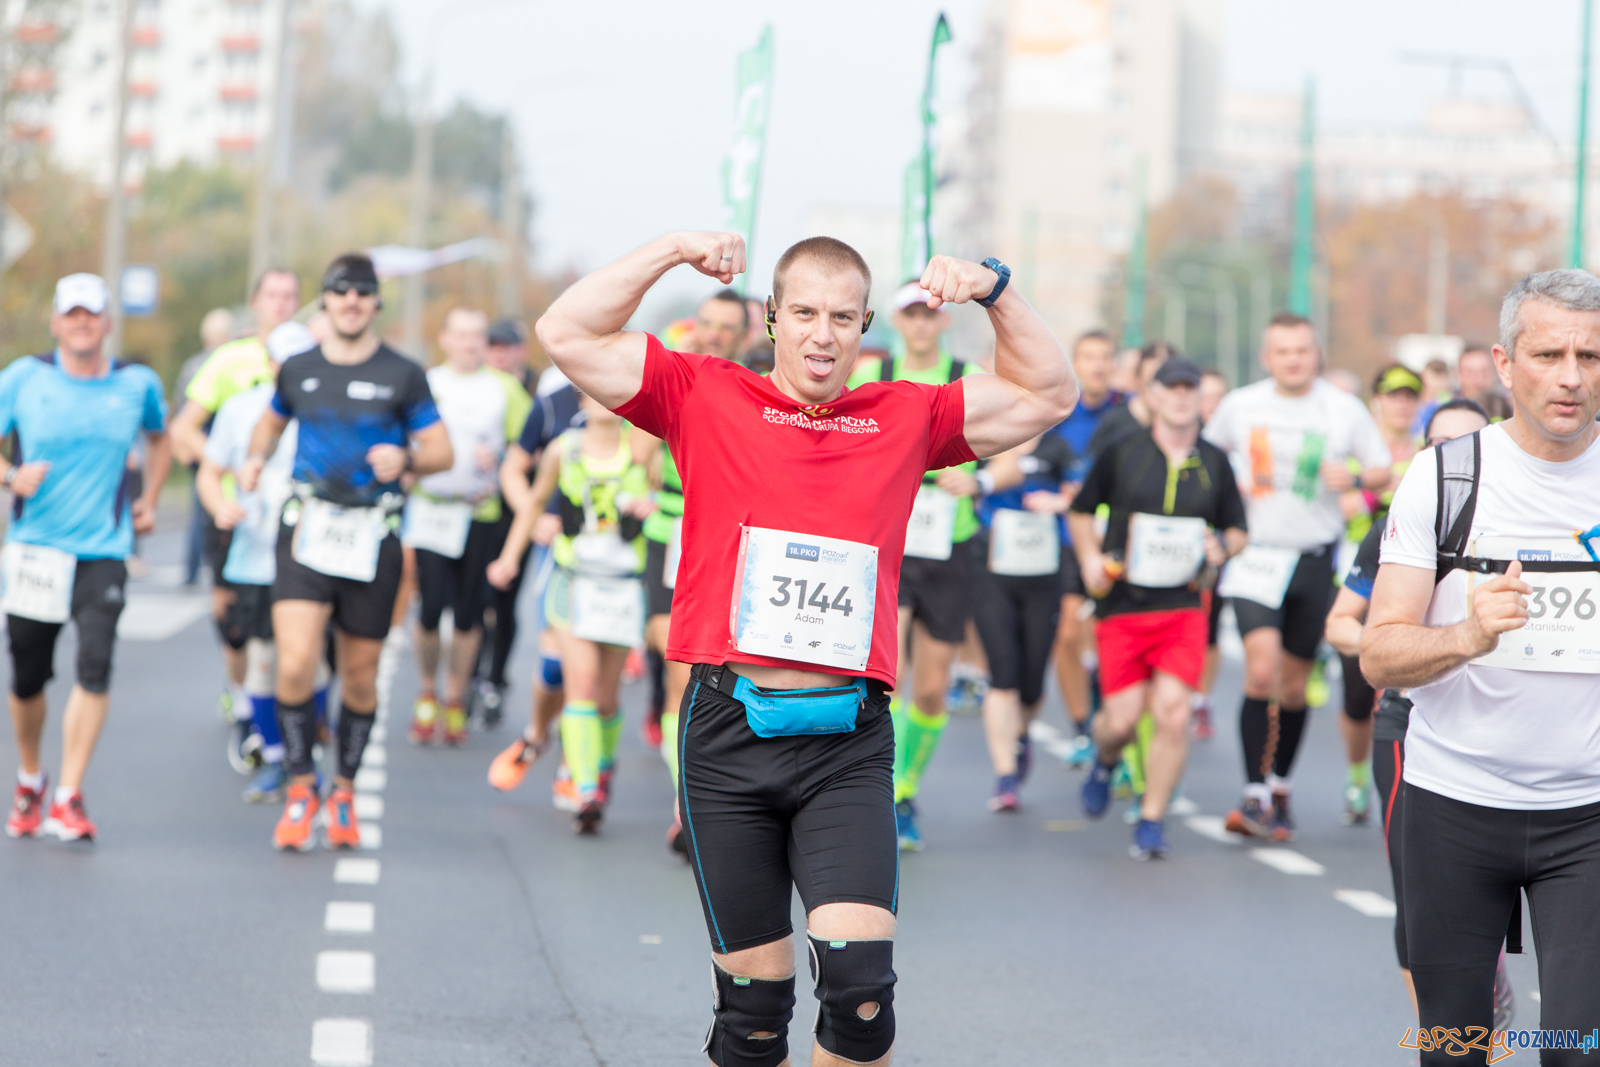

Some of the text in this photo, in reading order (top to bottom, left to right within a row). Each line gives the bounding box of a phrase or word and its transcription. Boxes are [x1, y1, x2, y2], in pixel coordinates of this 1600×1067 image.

[763, 414, 812, 430] POCZTOWA
[841, 425, 880, 434] BIEGOWA
[789, 546, 818, 558] 18. PKO
[1519, 553, 1531, 561] 18.
[821, 555, 847, 564] maraton
[769, 575, 854, 617] 3144
[794, 612, 825, 625] Adam
[1524, 621, 1576, 632] Stanisław
